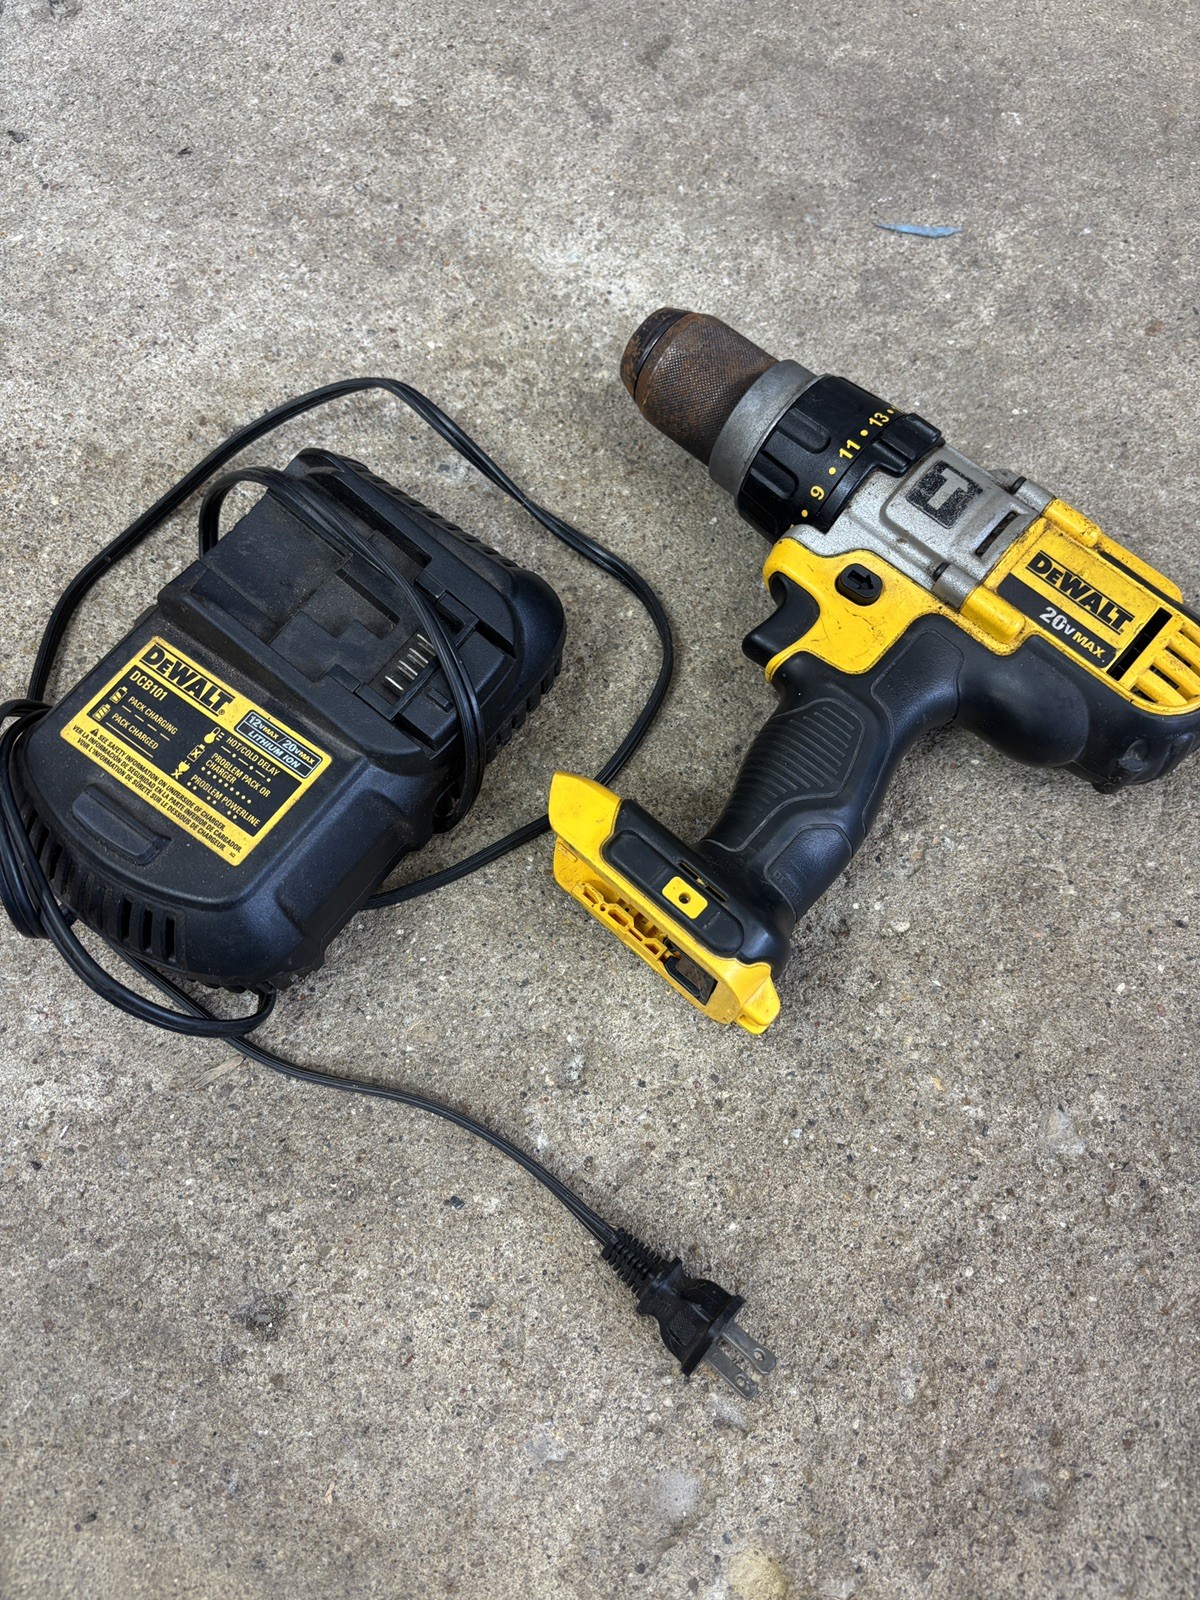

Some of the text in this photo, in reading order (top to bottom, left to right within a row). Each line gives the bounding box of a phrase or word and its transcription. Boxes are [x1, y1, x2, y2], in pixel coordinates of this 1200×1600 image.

[810, 412, 890, 500] 9 11 13
[1026, 551, 1134, 633] DEWALT
[128, 670, 168, 701] DCB101
[141, 644, 233, 714] DEWALT
[110, 712, 159, 750] PACK CHARGED
[127, 695, 178, 734] PACK CHARGING
[97, 734, 109, 744] SEE
[106, 741, 126, 757] SAFETY
[124, 754, 159, 781] INFORMATION
[157, 778, 167, 787] ON
[165, 784, 195, 808] UNDERSIDE
[193, 805, 202, 813] OF
[204, 758, 237, 784] CHARGER
[225, 736, 280, 777] HOT/COLD DELAY
[247, 729, 300, 769] LITHIUM ION
[71, 724, 83, 734] VER
[81, 731, 90, 739] LA
[120, 760, 129, 768] DE
[127, 765, 156, 788] SEGURIDAD
[154, 786, 163, 794] EN
[161, 791, 170, 799] LA
[168, 796, 186, 811] PARTE
[183, 807, 207, 827] INFERIOR
[205, 824, 214, 832] DE
[76, 737, 90, 749] VOIR
[124, 773, 133, 781] DE
[149, 792, 162, 803] SUR
[160, 800, 168, 808] LE
[166, 805, 191, 825] DESSOUS
[189, 822, 198, 830] DE
[210, 752, 271, 797] PROBLEM PACK OR
[190, 773, 260, 827] PROBLEM POWERLINE
